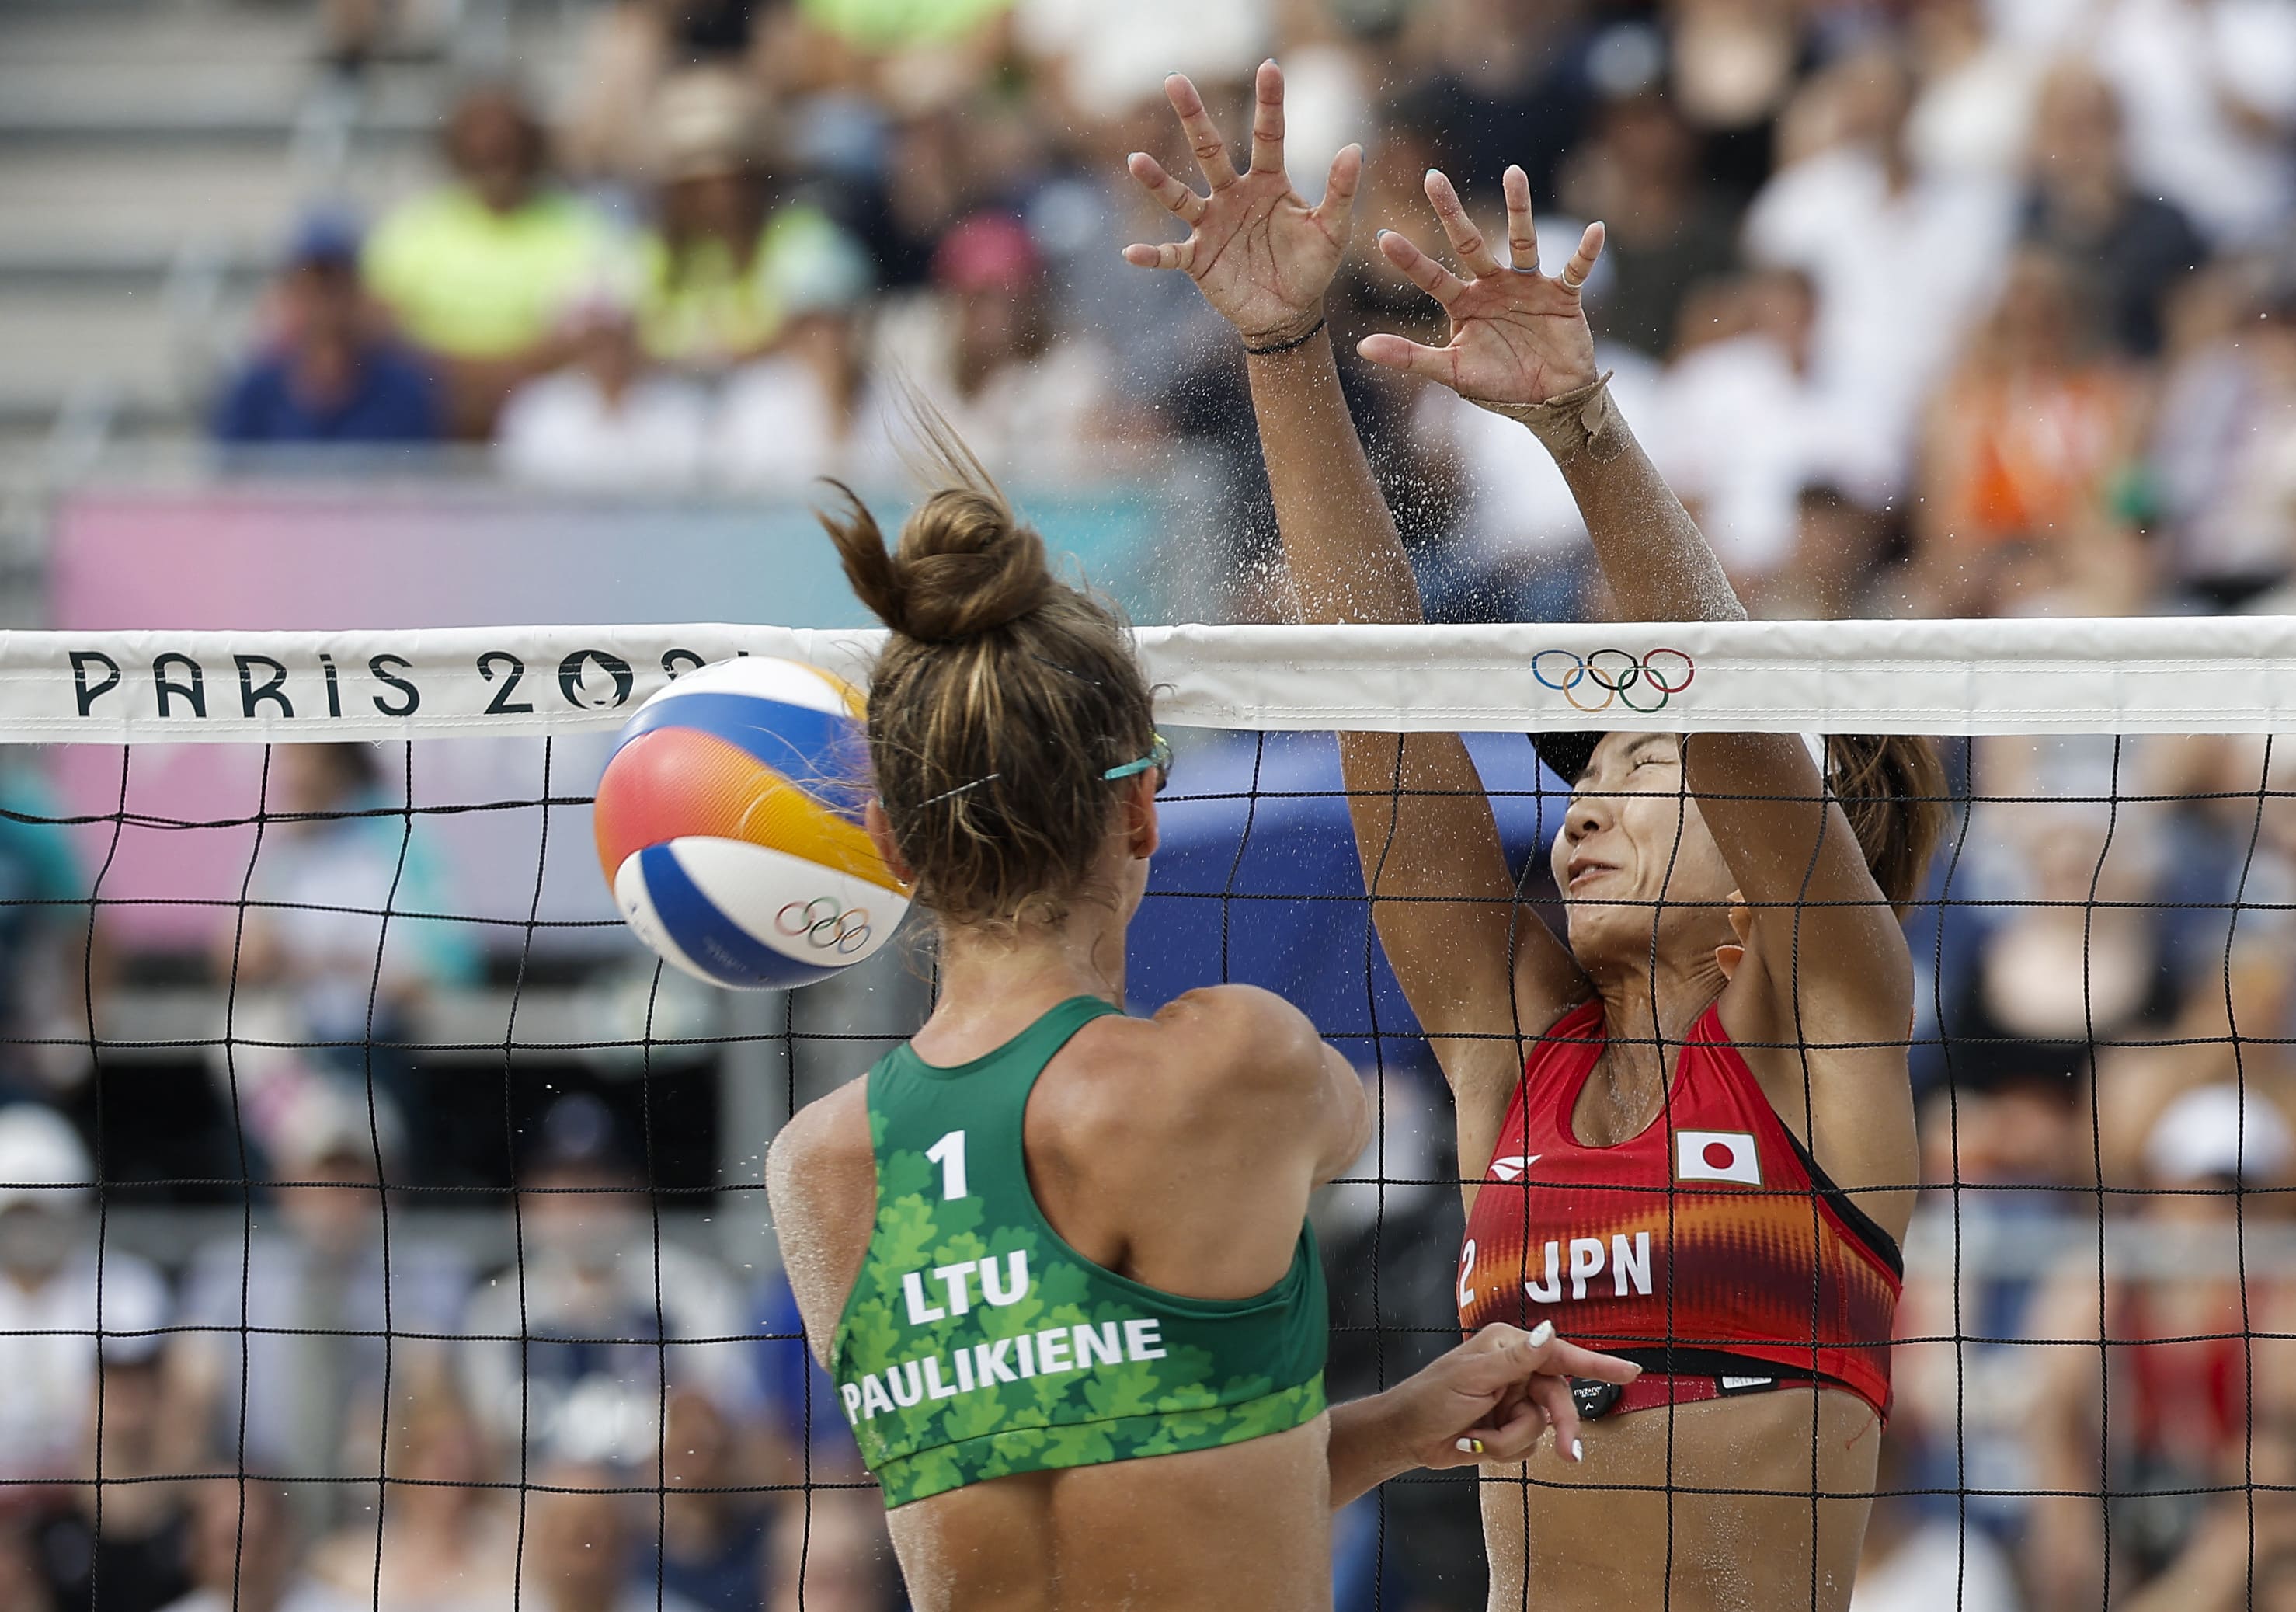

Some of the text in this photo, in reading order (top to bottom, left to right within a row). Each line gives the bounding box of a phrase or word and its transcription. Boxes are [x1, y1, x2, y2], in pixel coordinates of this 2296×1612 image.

[476, 649, 749, 715] 20
[924, 1130, 968, 1201] 1
[902, 1248, 1031, 1326] LTU
[1459, 1238, 1477, 1309] 2
[1524, 1231, 1653, 1304] JPN
[840, 1318, 1167, 1426] PAULIKIENE
